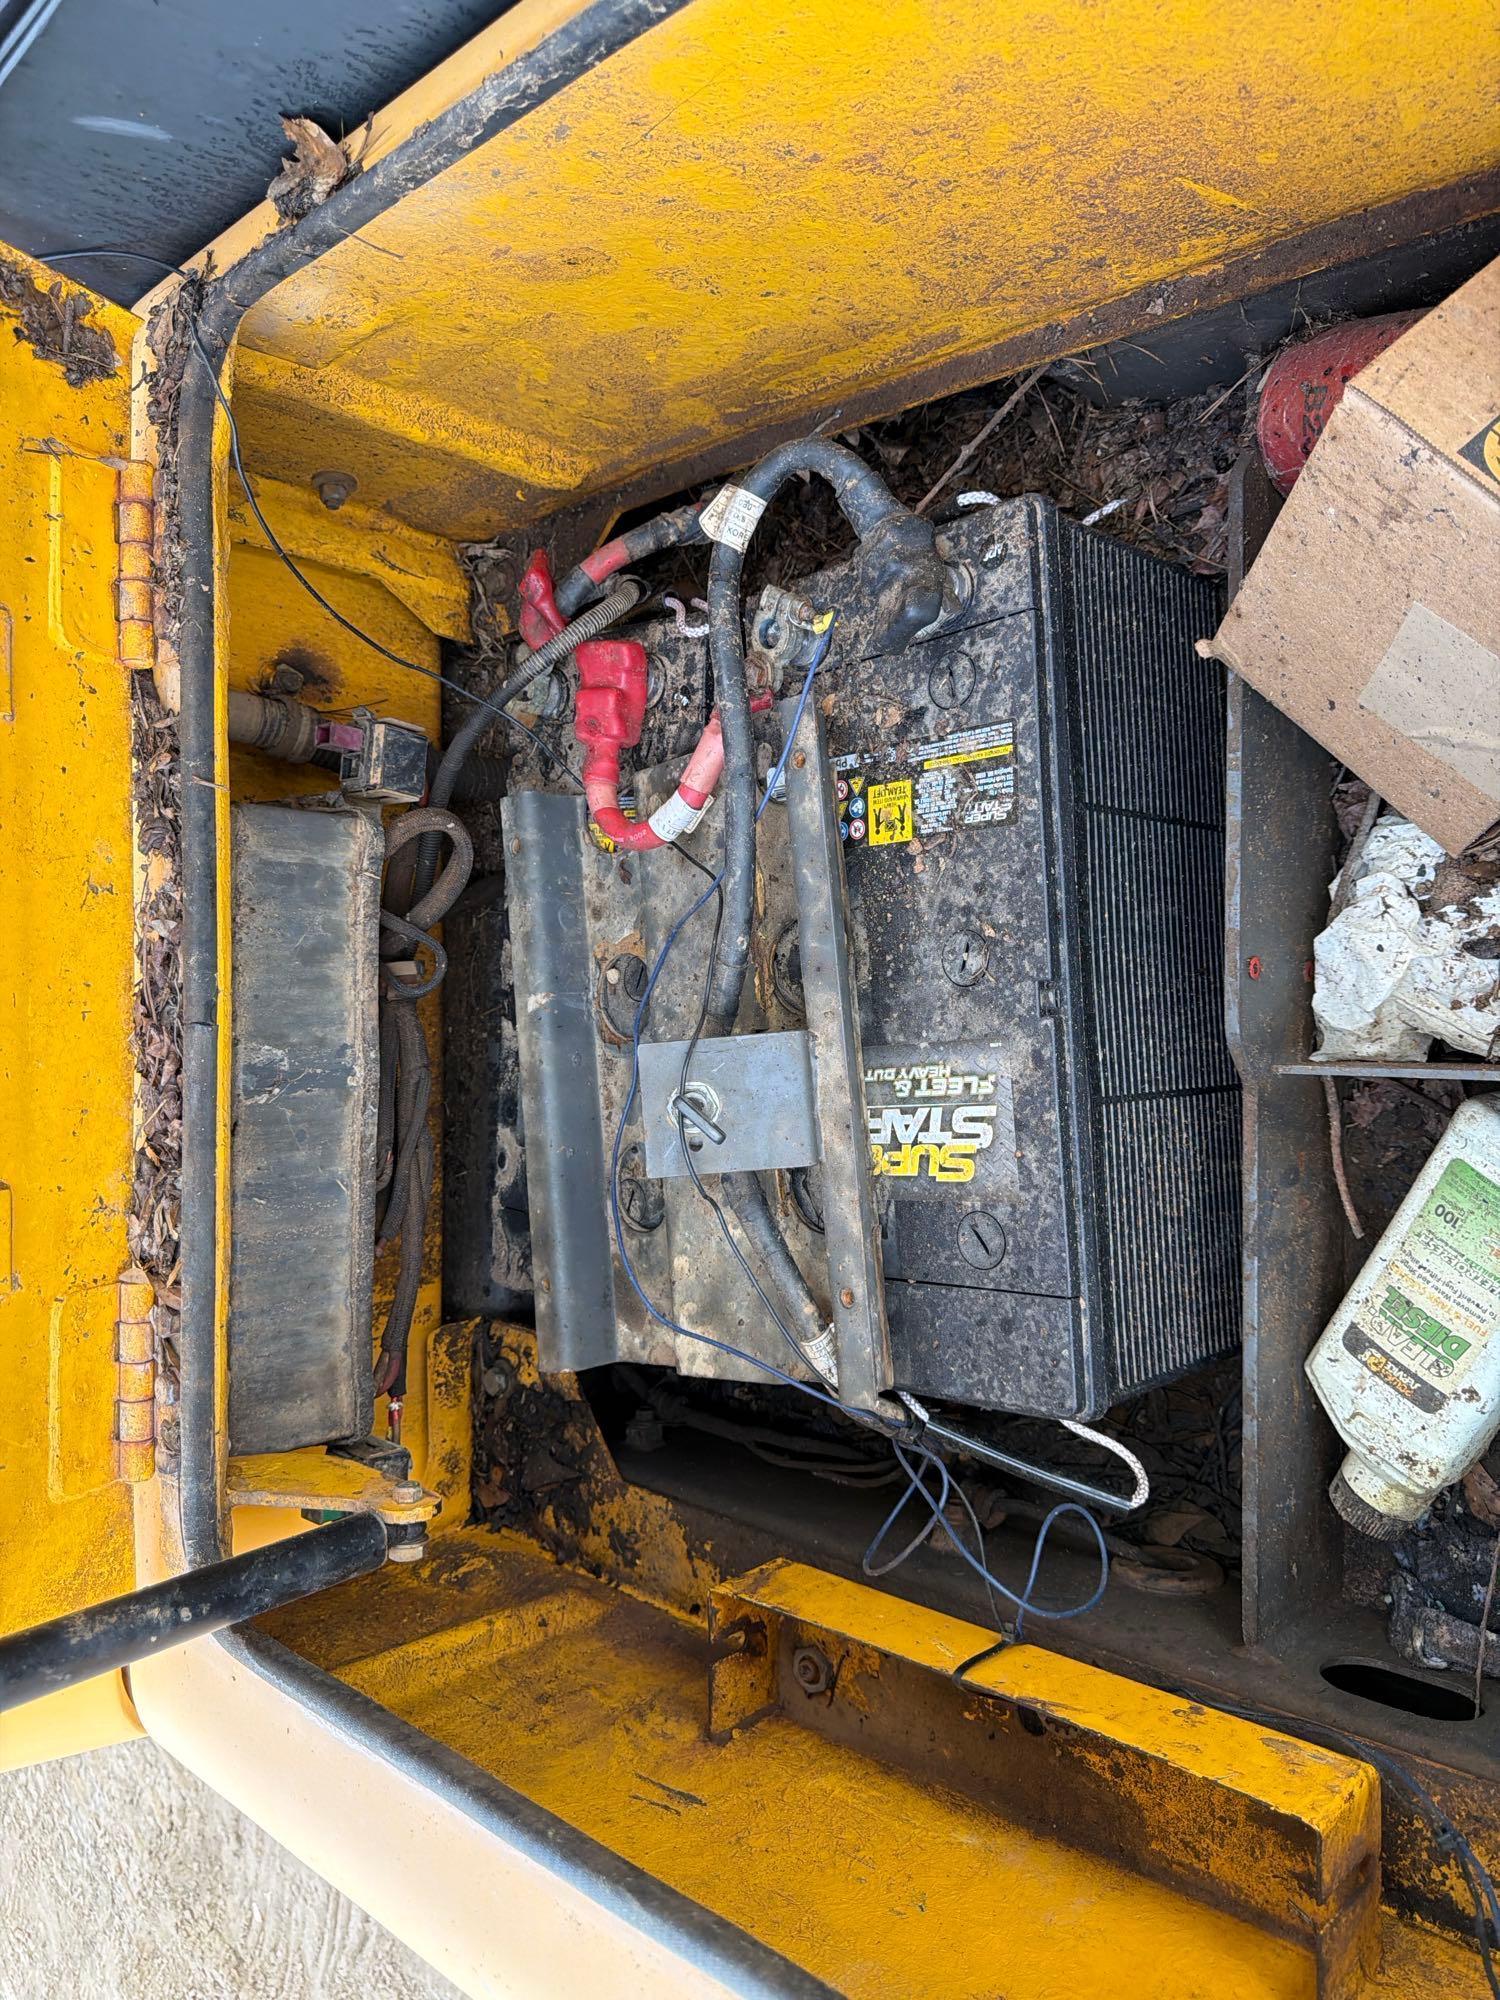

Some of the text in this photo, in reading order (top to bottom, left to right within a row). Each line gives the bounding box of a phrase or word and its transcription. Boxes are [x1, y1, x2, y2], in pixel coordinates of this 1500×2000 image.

[888, 785, 906, 797] TEAM
[965, 811, 1007, 824] SUPER
[864, 1065, 951, 1082] HEAVY DUT
[893, 1074, 997, 1098] FLEET &
[1434, 1203, 1461, 1229] 100
[1440, 1194, 1466, 1217] Gallons
[1417, 1274, 1431, 1285] and
[1431, 1284, 1452, 1301] Water
[1459, 1290, 1488, 1314] Prevent
[1381, 1285, 1472, 1361] DIESEL
[1452, 1299, 1487, 1324] Removes
[1488, 1311, 1498, 1321] To
[1464, 1317, 1488, 1337] FUEL
[1380, 1368, 1415, 1397] POWER
[1384, 1361, 1422, 1389] SERVICE
